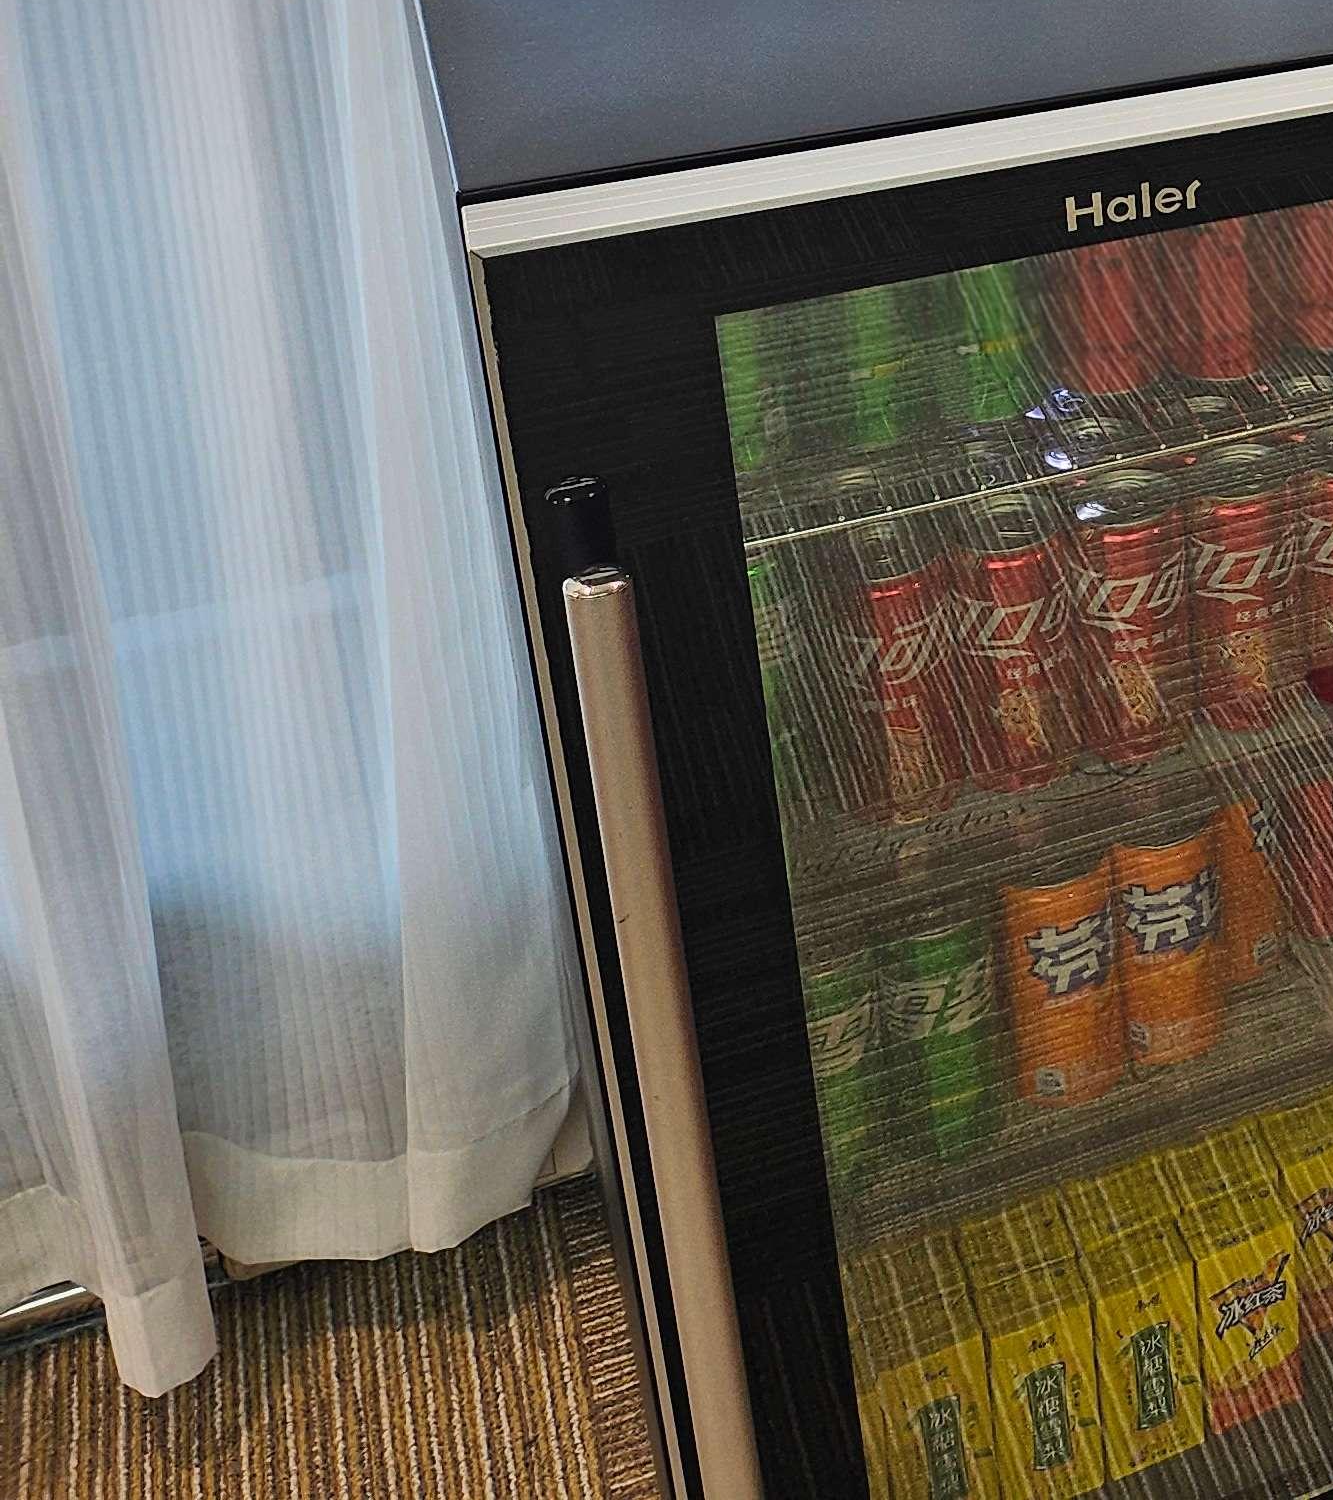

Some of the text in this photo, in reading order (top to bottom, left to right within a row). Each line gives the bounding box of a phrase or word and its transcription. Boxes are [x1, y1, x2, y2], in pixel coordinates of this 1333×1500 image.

[1218, 1282, 1286, 1333] 冰红茶
[1034, 1374, 1064, 1459] 冰糖雪梨
[1138, 1332, 1168, 1420] 冰糖雪梨
